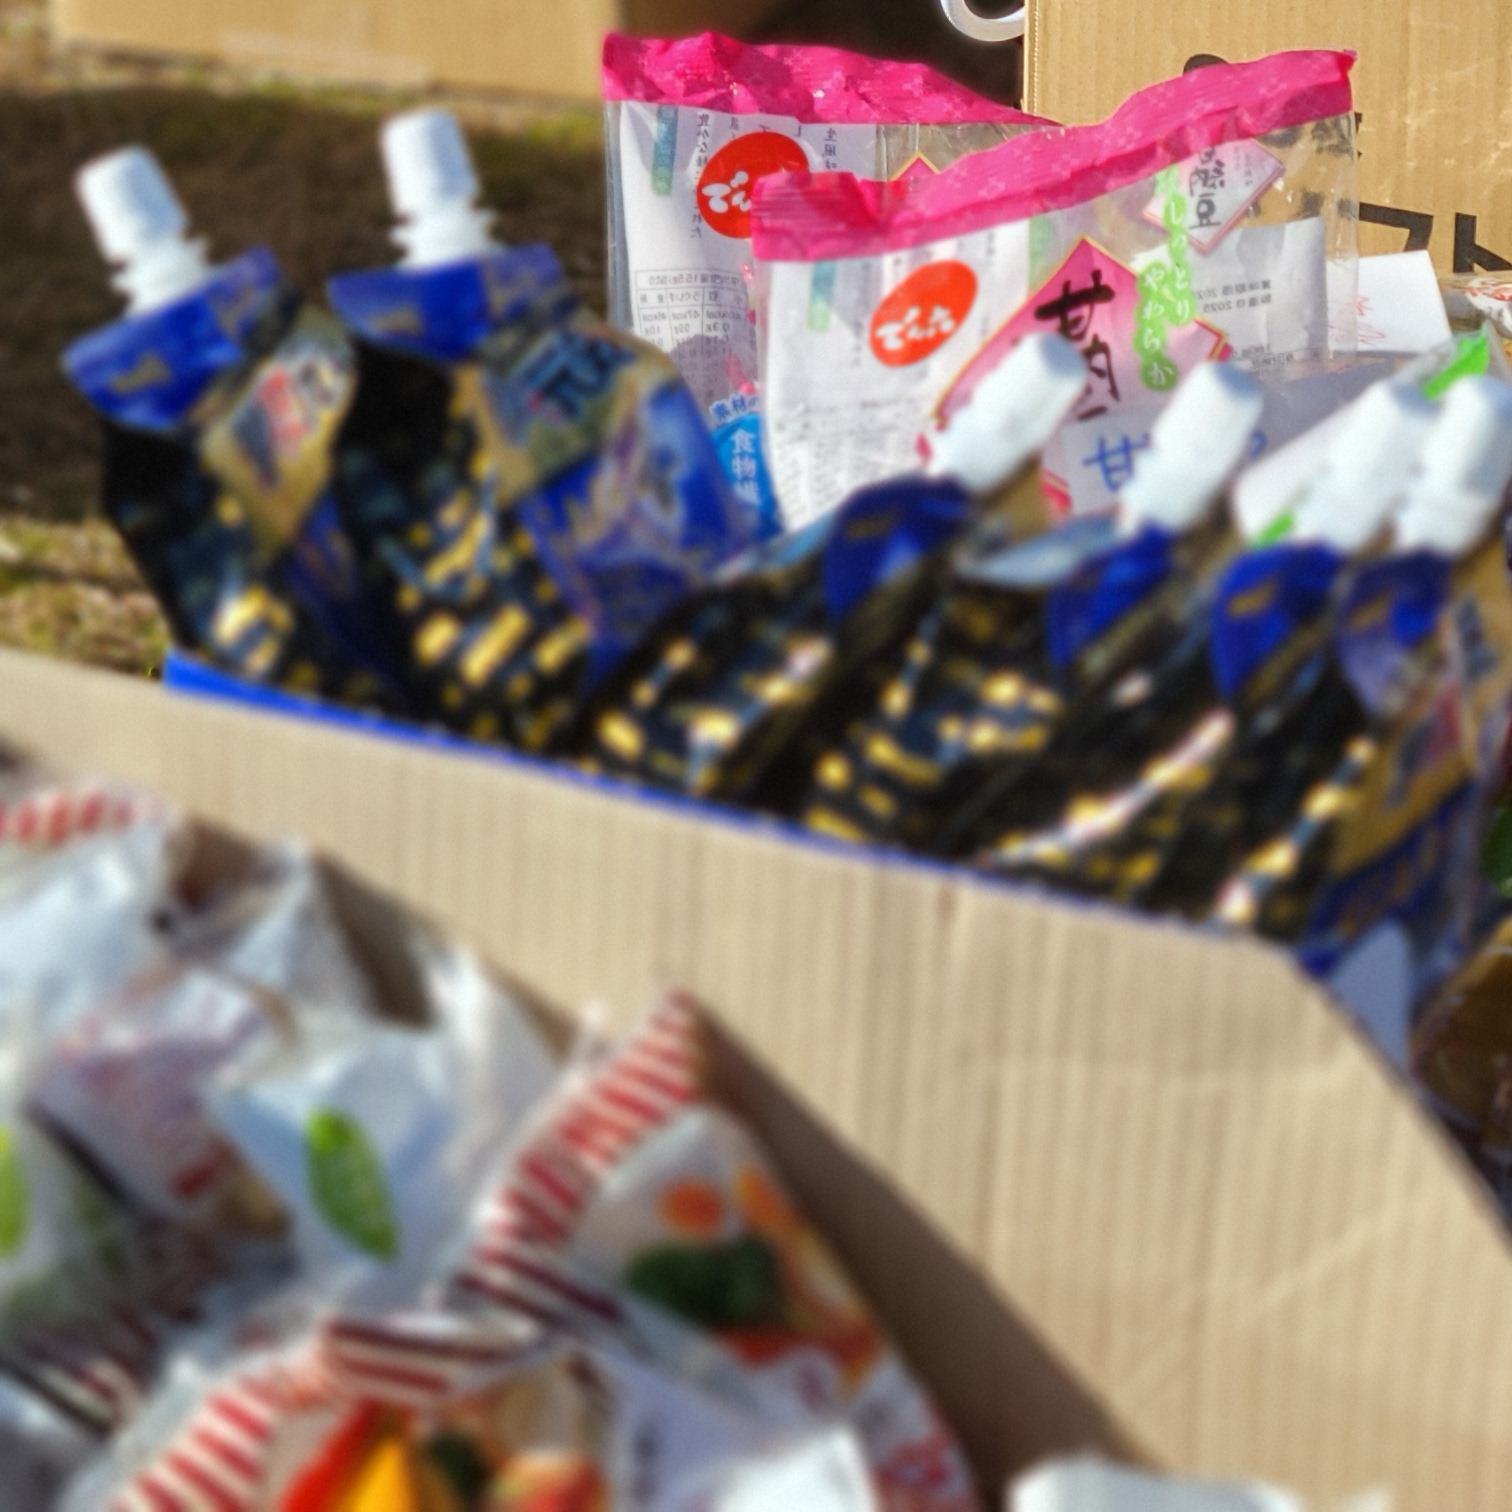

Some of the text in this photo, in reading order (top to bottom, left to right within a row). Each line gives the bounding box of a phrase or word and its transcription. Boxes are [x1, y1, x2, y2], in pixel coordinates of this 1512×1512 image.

[874, 304, 956, 351] でん六
[1144, 266, 1173, 386] やわらか
